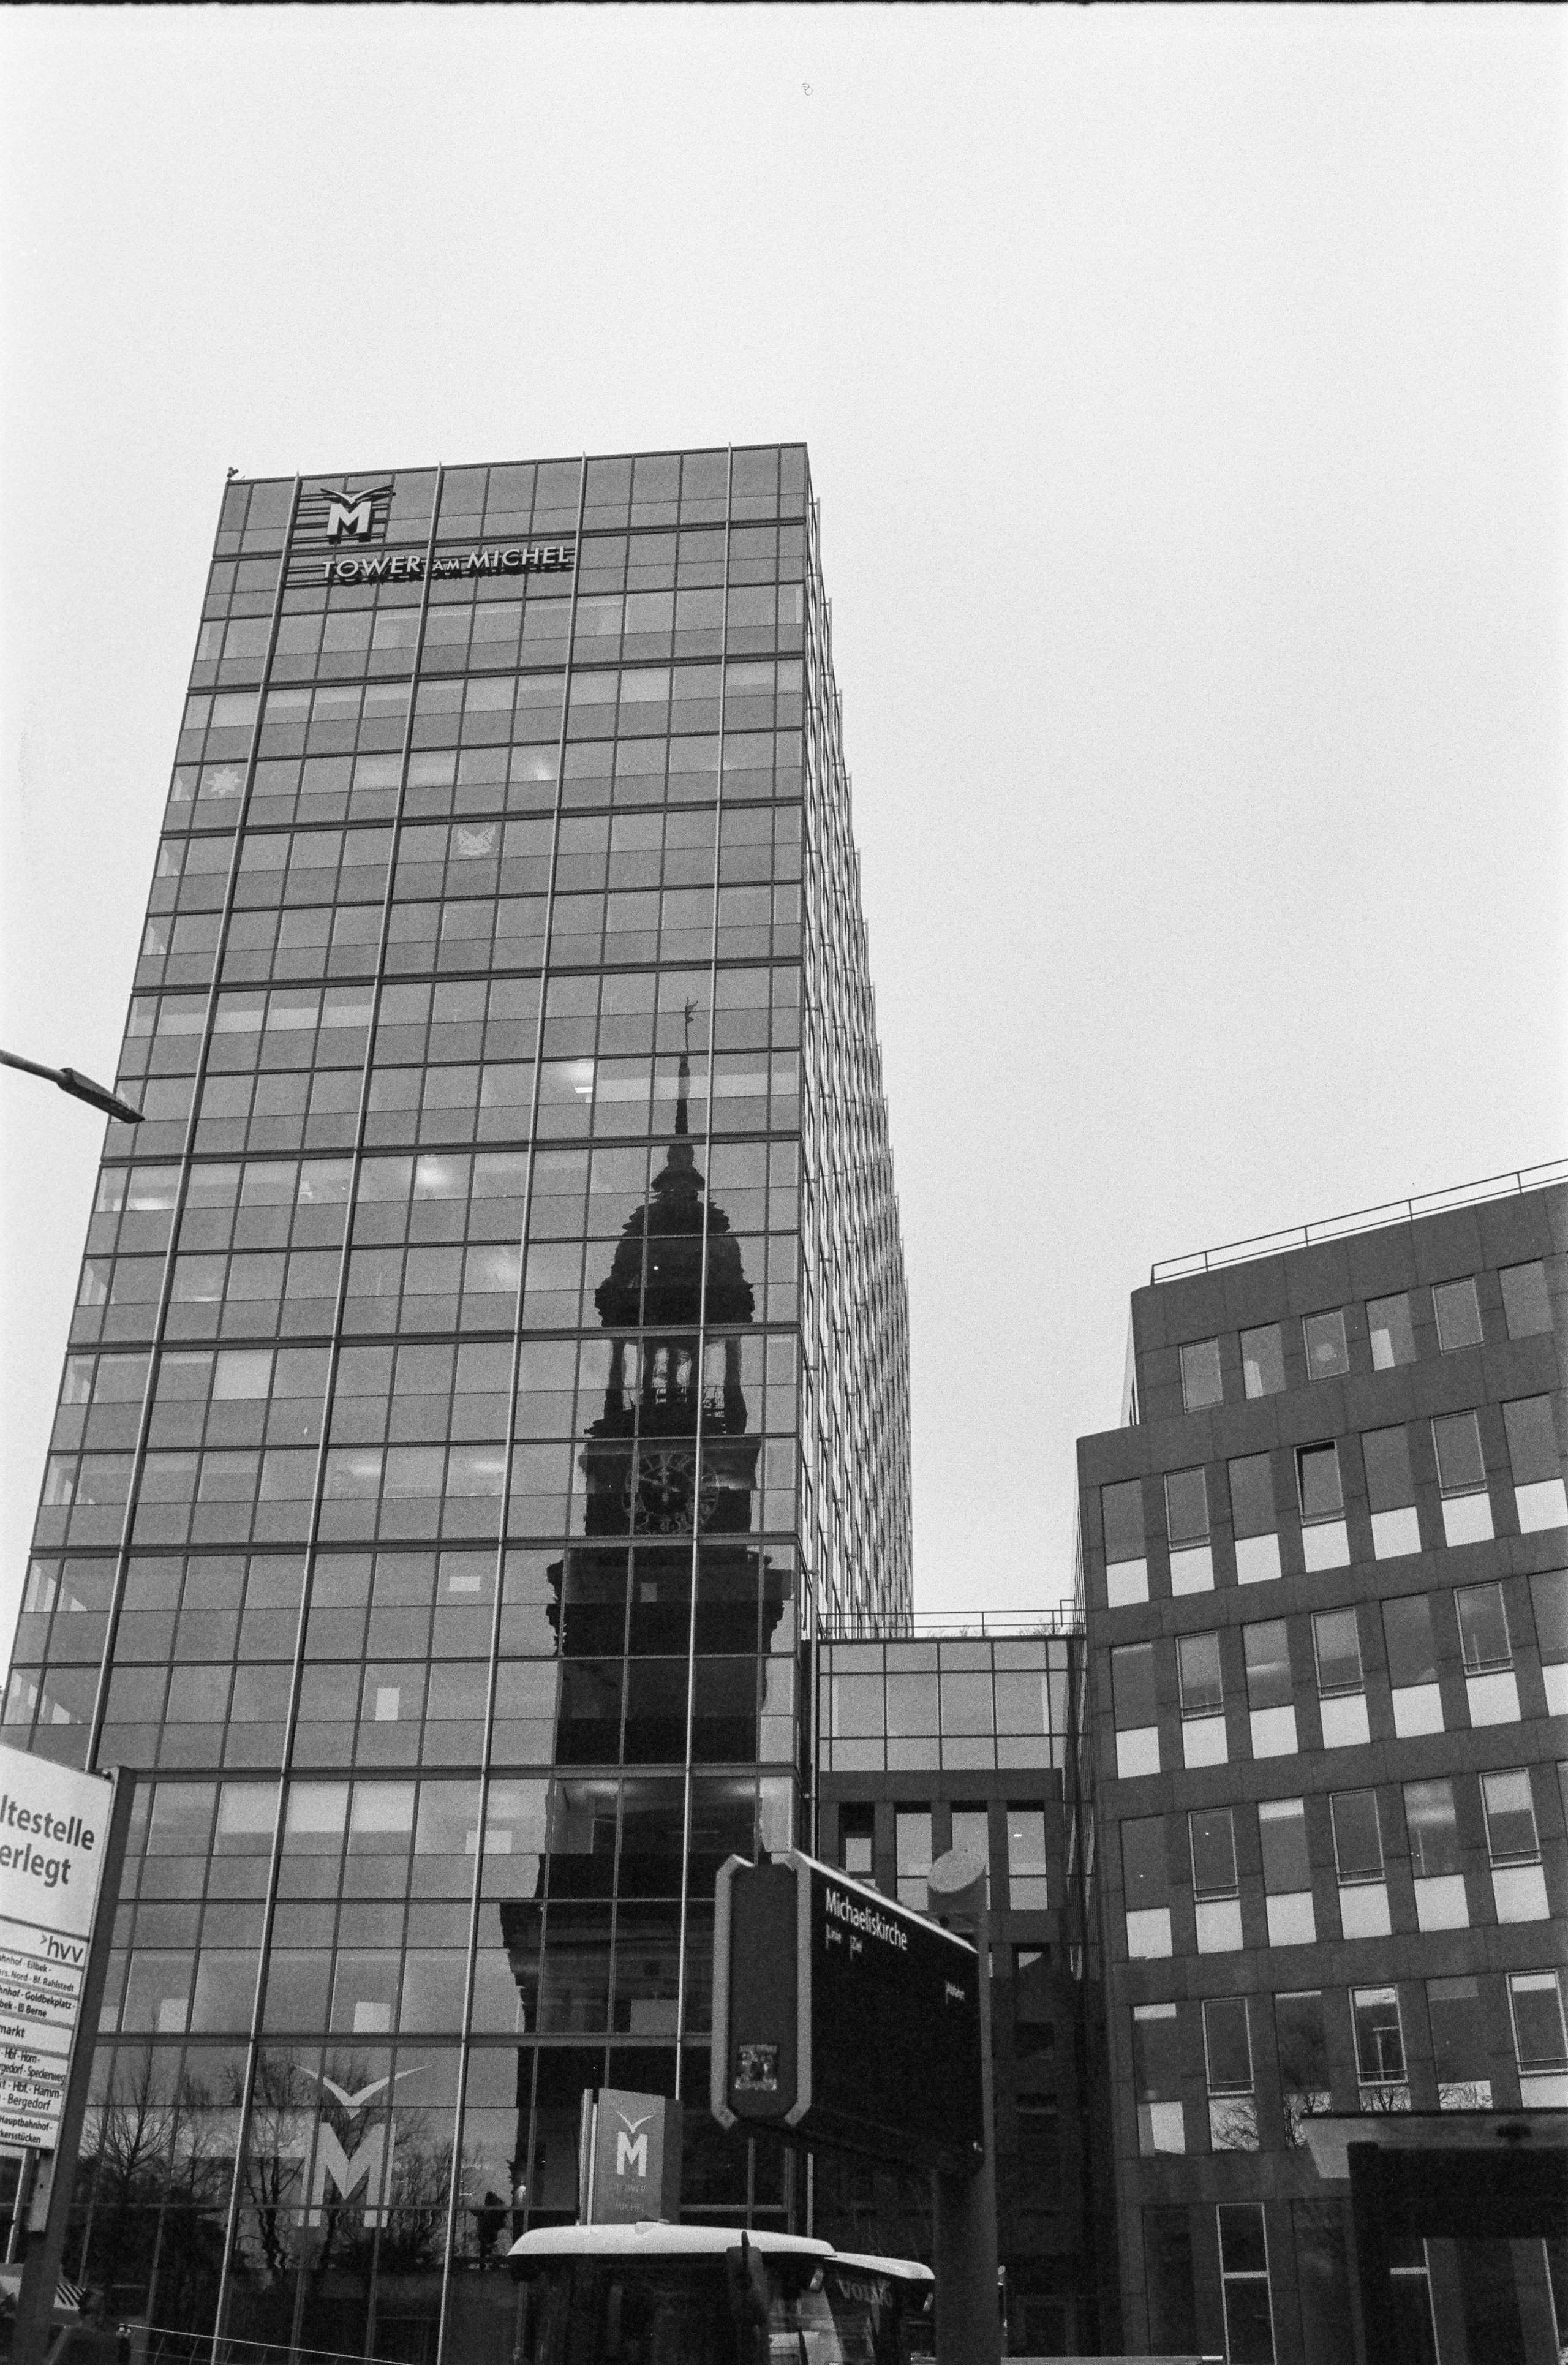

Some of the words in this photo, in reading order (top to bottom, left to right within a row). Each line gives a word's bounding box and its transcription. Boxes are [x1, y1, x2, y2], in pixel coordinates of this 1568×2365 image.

[322, 554, 421, 579] TOWER
[432, 558, 461, 571] AM
[467, 546, 570, 568] MICHEL
[0, 1794, 95, 1850] ltestelle
[0, 1843, 71, 1888] erlegt
[826, 1887, 907, 1951] Michaeliskirche
[47, 1936, 84, 1963] hvv
[27, 1960, 47, 1972] Eilbek
[11, 1971, 29, 1982] Nord
[43, 1978, 74, 1992] Rahlstedt
[25, 1991, 72, 2010] Goldbekplatz
[26, 2005, 47, 2018] Berne
[0, 2024, 25, 2038] markt
[7, 2093, 51, 2110] Bergedorf
